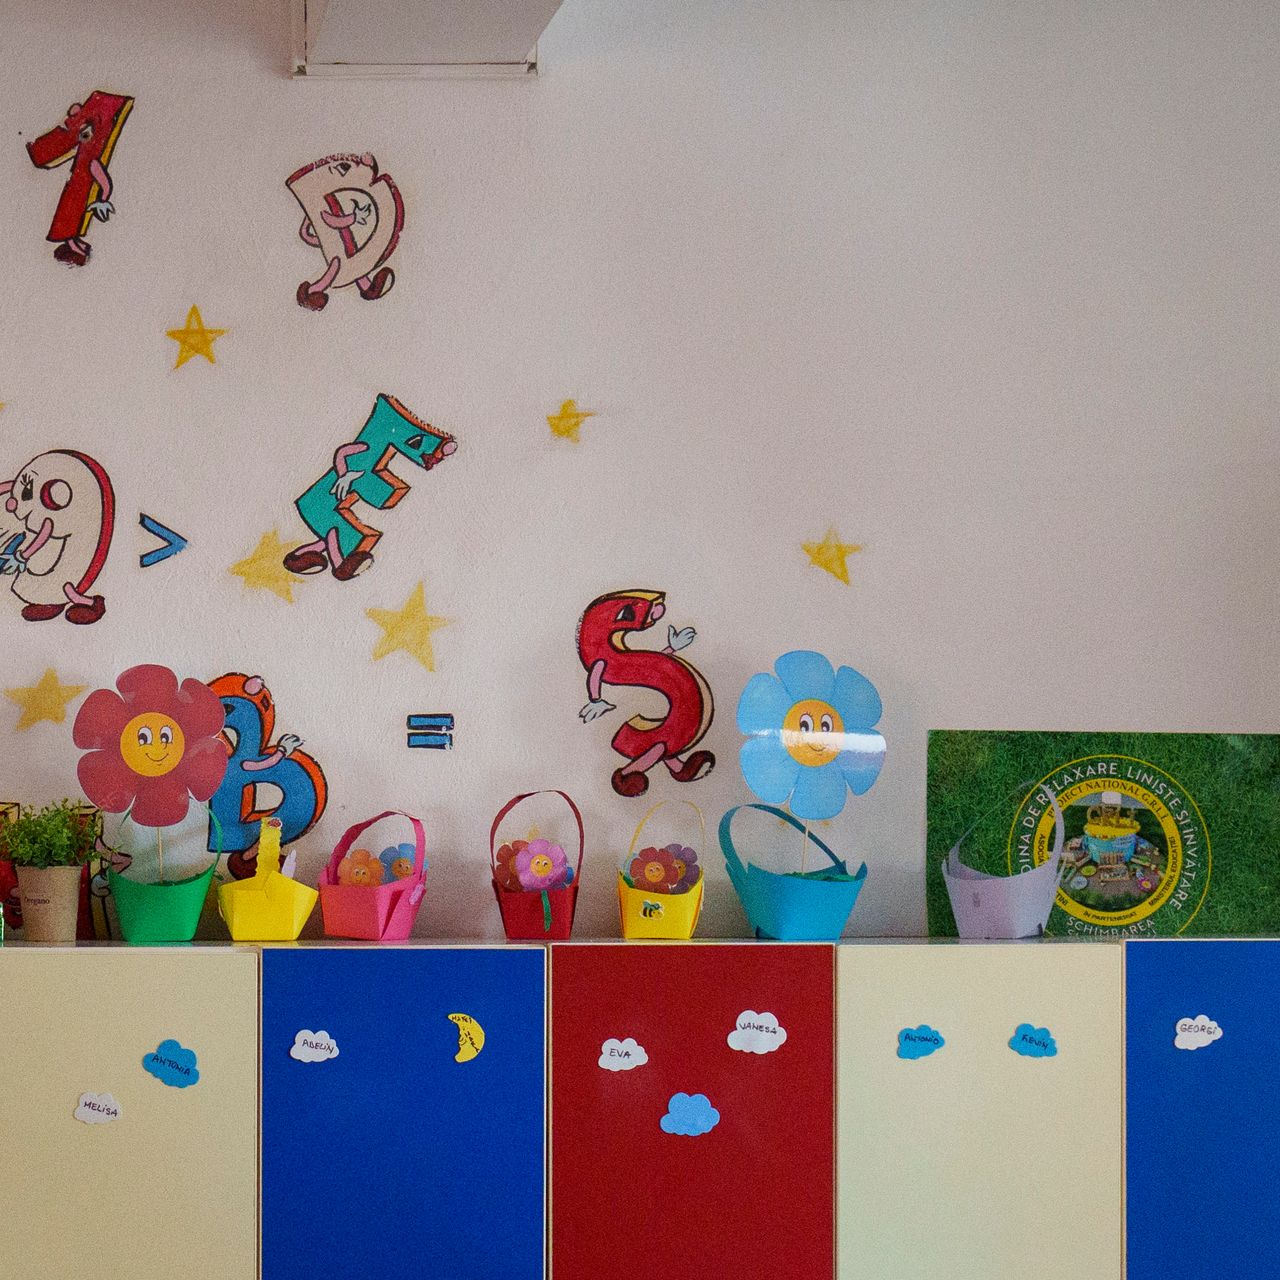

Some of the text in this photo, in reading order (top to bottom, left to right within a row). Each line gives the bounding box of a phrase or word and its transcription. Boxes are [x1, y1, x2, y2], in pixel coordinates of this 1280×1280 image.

[26, 90, 134, 241] 1
[286, 152, 405, 289] D
[11, 448, 116, 607] 9
[295, 393, 458, 560] E
[575, 588, 715, 761] S
[1023, 805, 1041, 829] DE
[1066, 915, 1156, 936] SCHIMBAREA
[609, 1048, 632, 1060] EVA
[738, 1022, 778, 1035] VANESA
